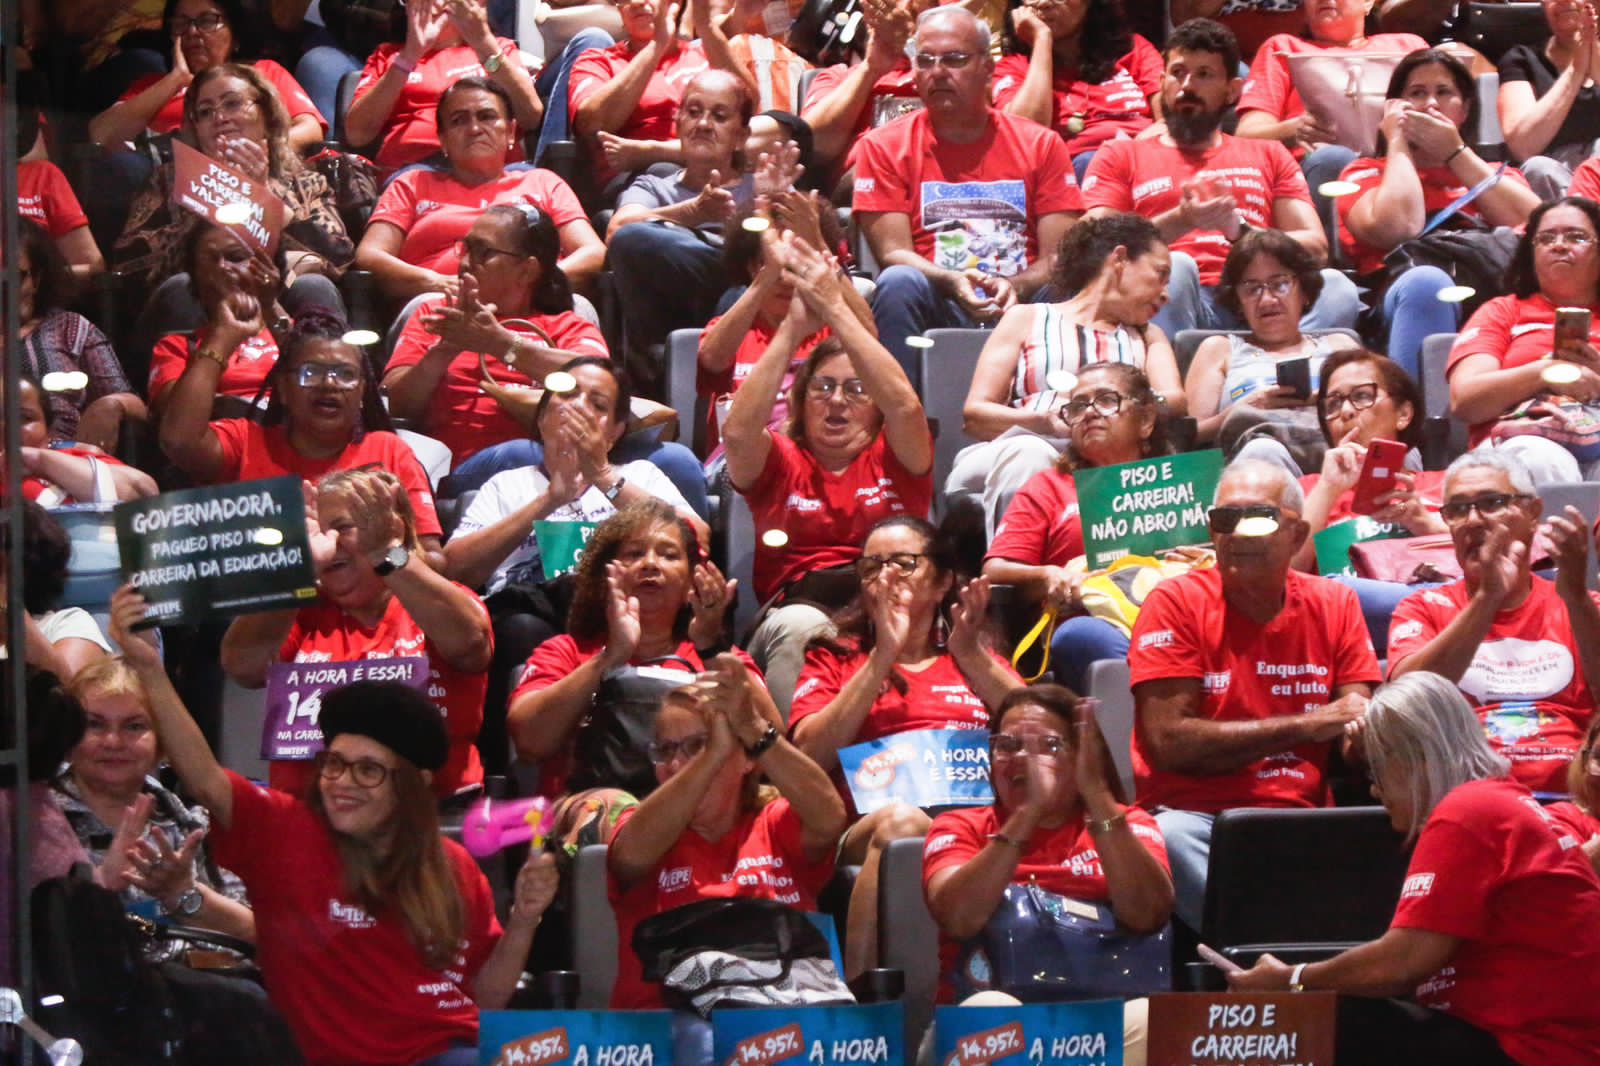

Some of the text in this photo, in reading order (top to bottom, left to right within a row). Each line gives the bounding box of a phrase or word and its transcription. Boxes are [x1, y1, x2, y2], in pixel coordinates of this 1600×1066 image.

[208, 163, 252, 195] PISO E
[1120, 462, 1174, 489] PISO E
[1112, 481, 1195, 513] CARREIRA!
[1091, 516, 1128, 541] NÃO
[1132, 511, 1178, 536] ABRO
[211, 530, 243, 550] PISO
[131, 546, 303, 589] CARREIRA DA EDUCAÇÃO!
[287, 663, 413, 687] A HORA É ESSA!
[1271, 684, 1292, 696] eu
[277, 730, 293, 741] NA
[922, 748, 937, 766] A
[941, 747, 989, 764] HORA
[1209, 1003, 1276, 1028] PISO E
[573, 1044, 589, 1066] A
[597, 1043, 653, 1066] HORA
[809, 1039, 824, 1064] A
[832, 1036, 888, 1063] HORA
[1029, 1037, 1044, 1062] A
[1051, 1032, 1107, 1058] HORA
[1191, 1032, 1297, 1060] CARREIRA!
